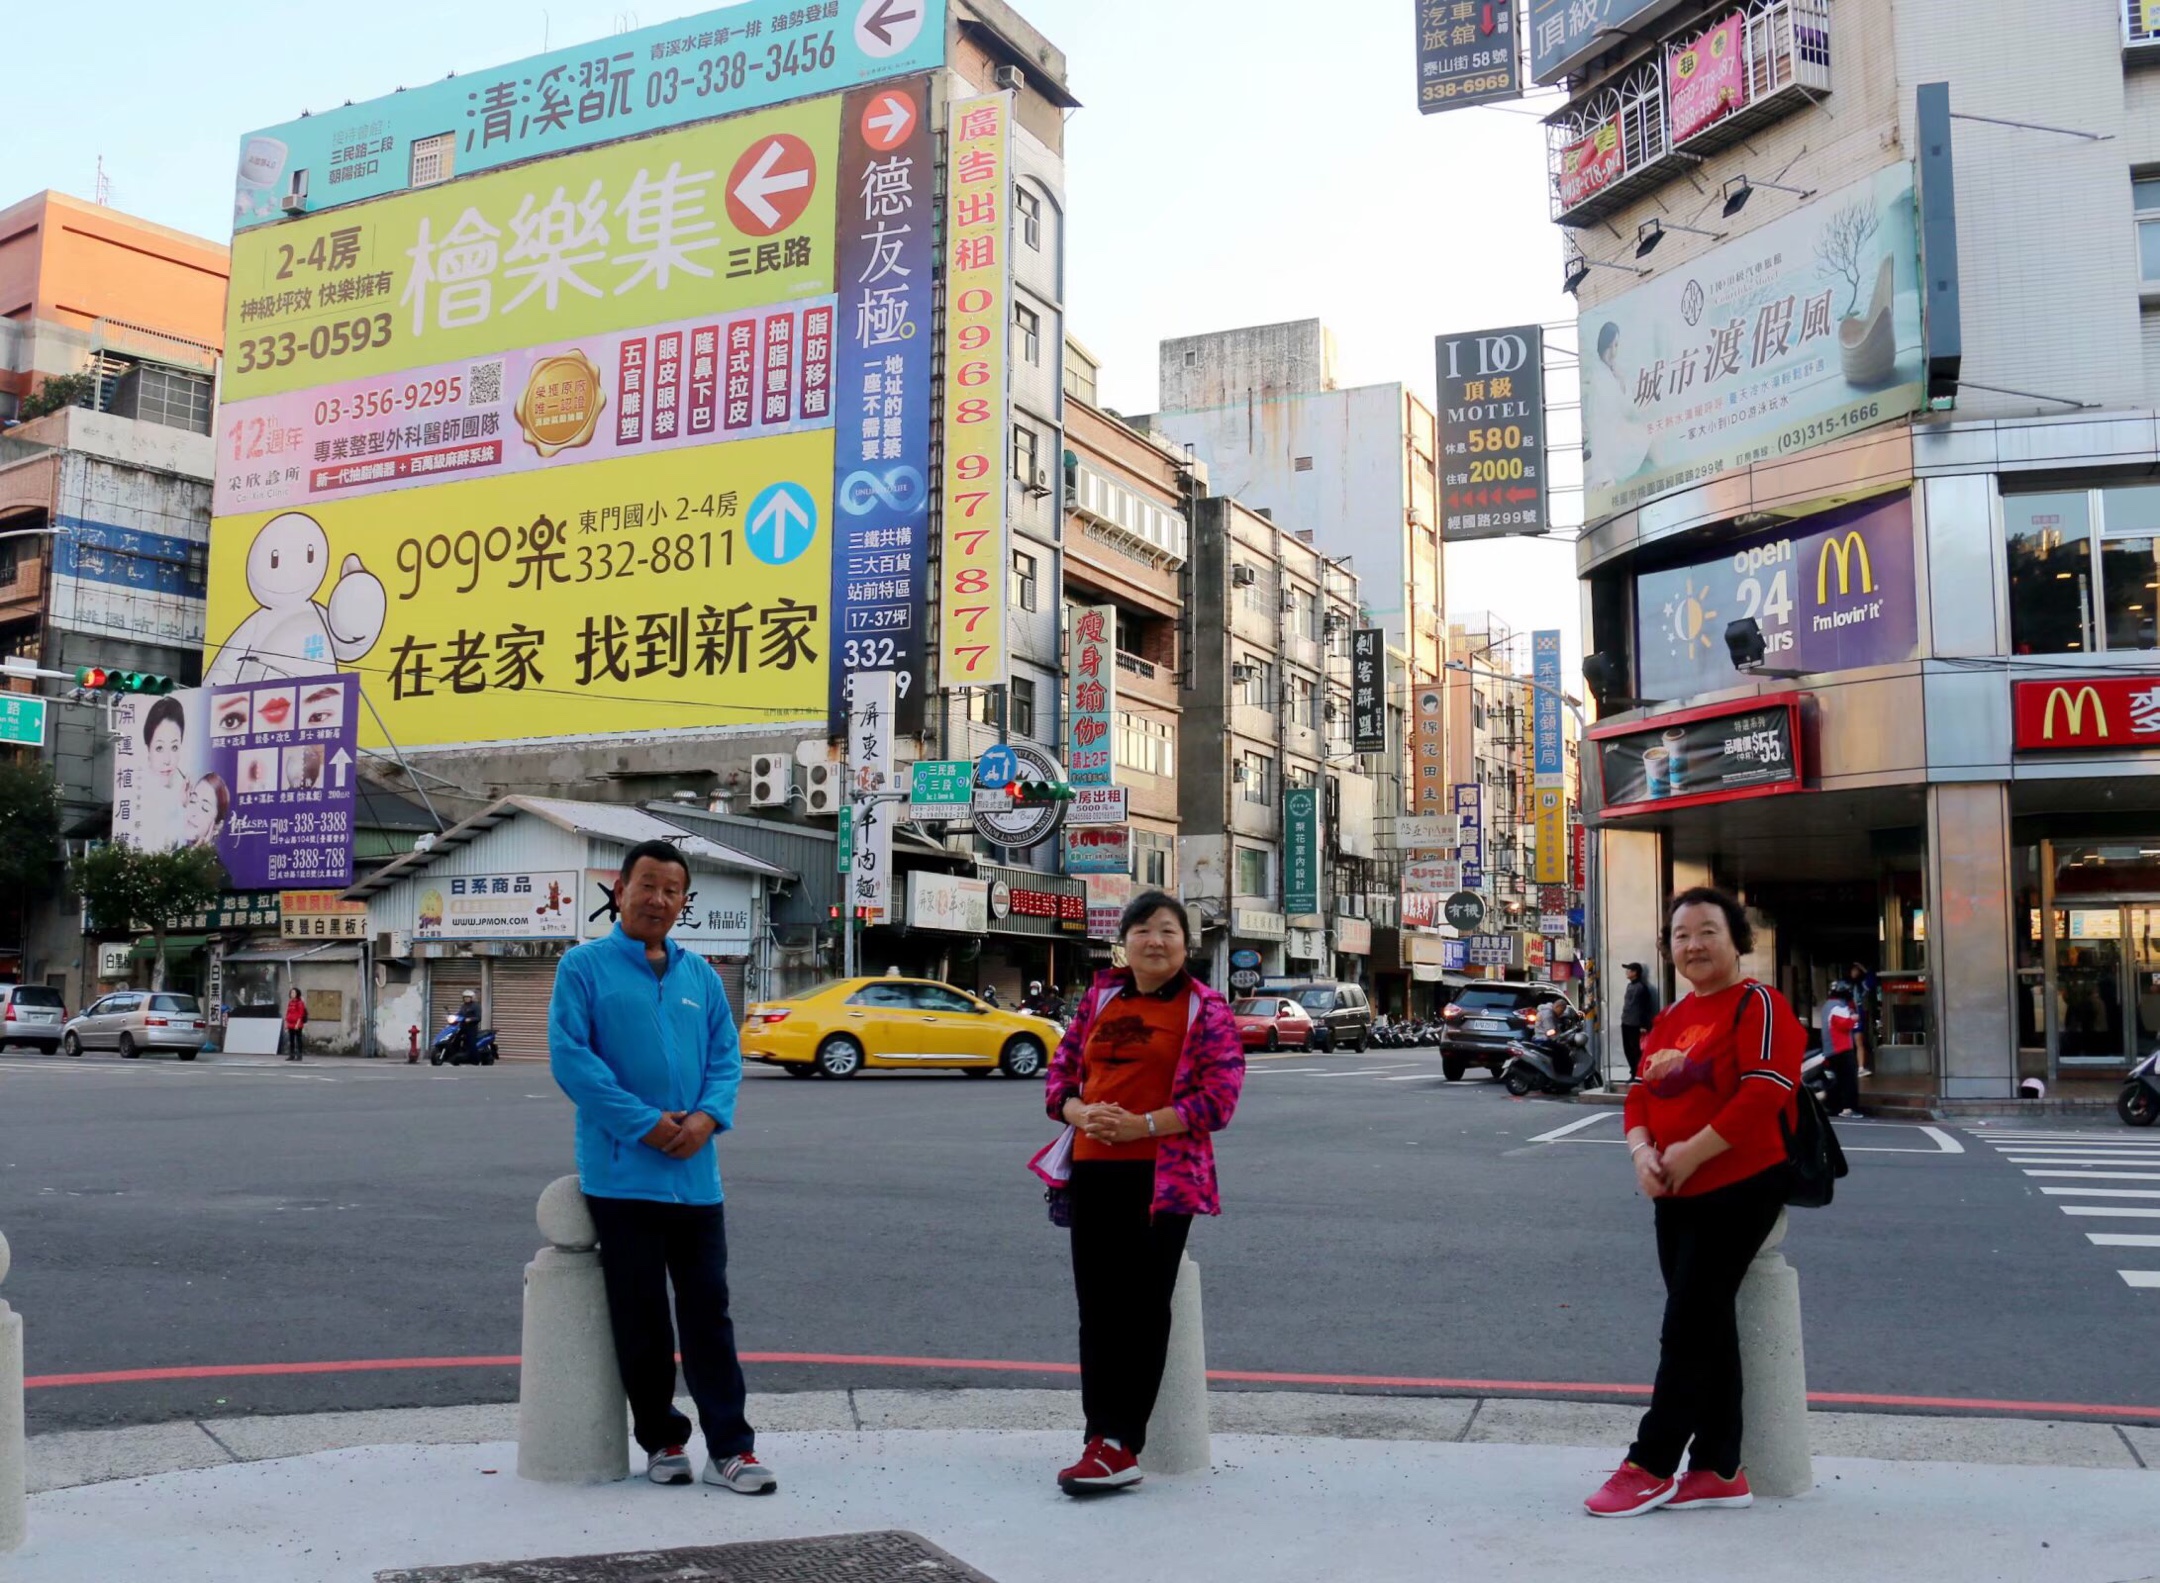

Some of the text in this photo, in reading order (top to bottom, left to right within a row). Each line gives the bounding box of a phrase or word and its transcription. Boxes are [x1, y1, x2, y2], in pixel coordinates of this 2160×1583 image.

[650, 1, 839, 61] 青溪水岸第一排 強勢登場
[1422, 1, 1476, 28] 汽車
[1536, 0, 1613, 59] 頂級
[646, 30, 836, 108] 03-338-3456
[1423, 74, 1509, 100] 338-6969
[1424, 57, 1468, 76] 泰山街
[328, 158, 379, 185] 朝陽街口
[331, 136, 393, 166] 三民路二段
[955, 105, 999, 272] 廣告出租
[275, 226, 363, 281] 2-4房
[401, 161, 722, 337] 檜樂集
[726, 236, 811, 279] 三民路
[240, 271, 394, 323] 神級坪效 快樂擁有
[236, 312, 393, 374] 333-0593
[804, 312, 829, 413] 脂肪移植
[1633, 288, 1834, 408] 城市渡假風
[621, 343, 643, 440] 五官雕塑
[655, 337, 678, 434] 眼皮眼袋
[691, 331, 715, 430] 隆鼻下巴
[728, 325, 752, 425] 各式拉皮
[765, 319, 790, 419] 抽脂豐胸
[1463, 376, 1513, 402] 頂級
[314, 375, 462, 426] 03-356-9295
[861, 360, 881, 461] 一座不需要
[883, 355, 904, 460] 地址的建築
[1447, 400, 1530, 424] MOTEL
[313, 411, 501, 463] 專業整型外科醫師團隊
[1468, 425, 1521, 454] 580
[1777, 402, 1879, 453] (03)315-1666
[410, 446, 495, 475] 百萬級麻醉系統
[1469, 457, 1524, 484] 2000
[577, 490, 739, 537] 東門國小 2-4房
[1447, 509, 1538, 531] 經國路299號
[575, 528, 734, 583] 332-8811
[848, 527, 912, 550] 三鐵共構
[1733, 537, 1792, 577] open
[848, 552, 912, 576] 三大百貨
[847, 579, 911, 602] 站前特區
[1735, 569, 1794, 630] 24
[850, 608, 908, 628] 17-37坪
[386, 597, 819, 702] 在老家 找到新家
[843, 637, 907, 668] 332-
[1072, 610, 1108, 748] 瘦身瑜伽
[928, 764, 957, 777] 三民路
[1072, 751, 1110, 770] 請上2F
[278, 810, 348, 834] 03-338-3388
[276, 847, 346, 870] 03-3388-788
[451, 875, 532, 896] 日系商品
[451, 916, 530, 927] WWW.JPMON.COM
[708, 909, 748, 930] 精品店
[1447, 902, 1481, 919] 有機
[210, 964, 222, 1023] 白黑板
